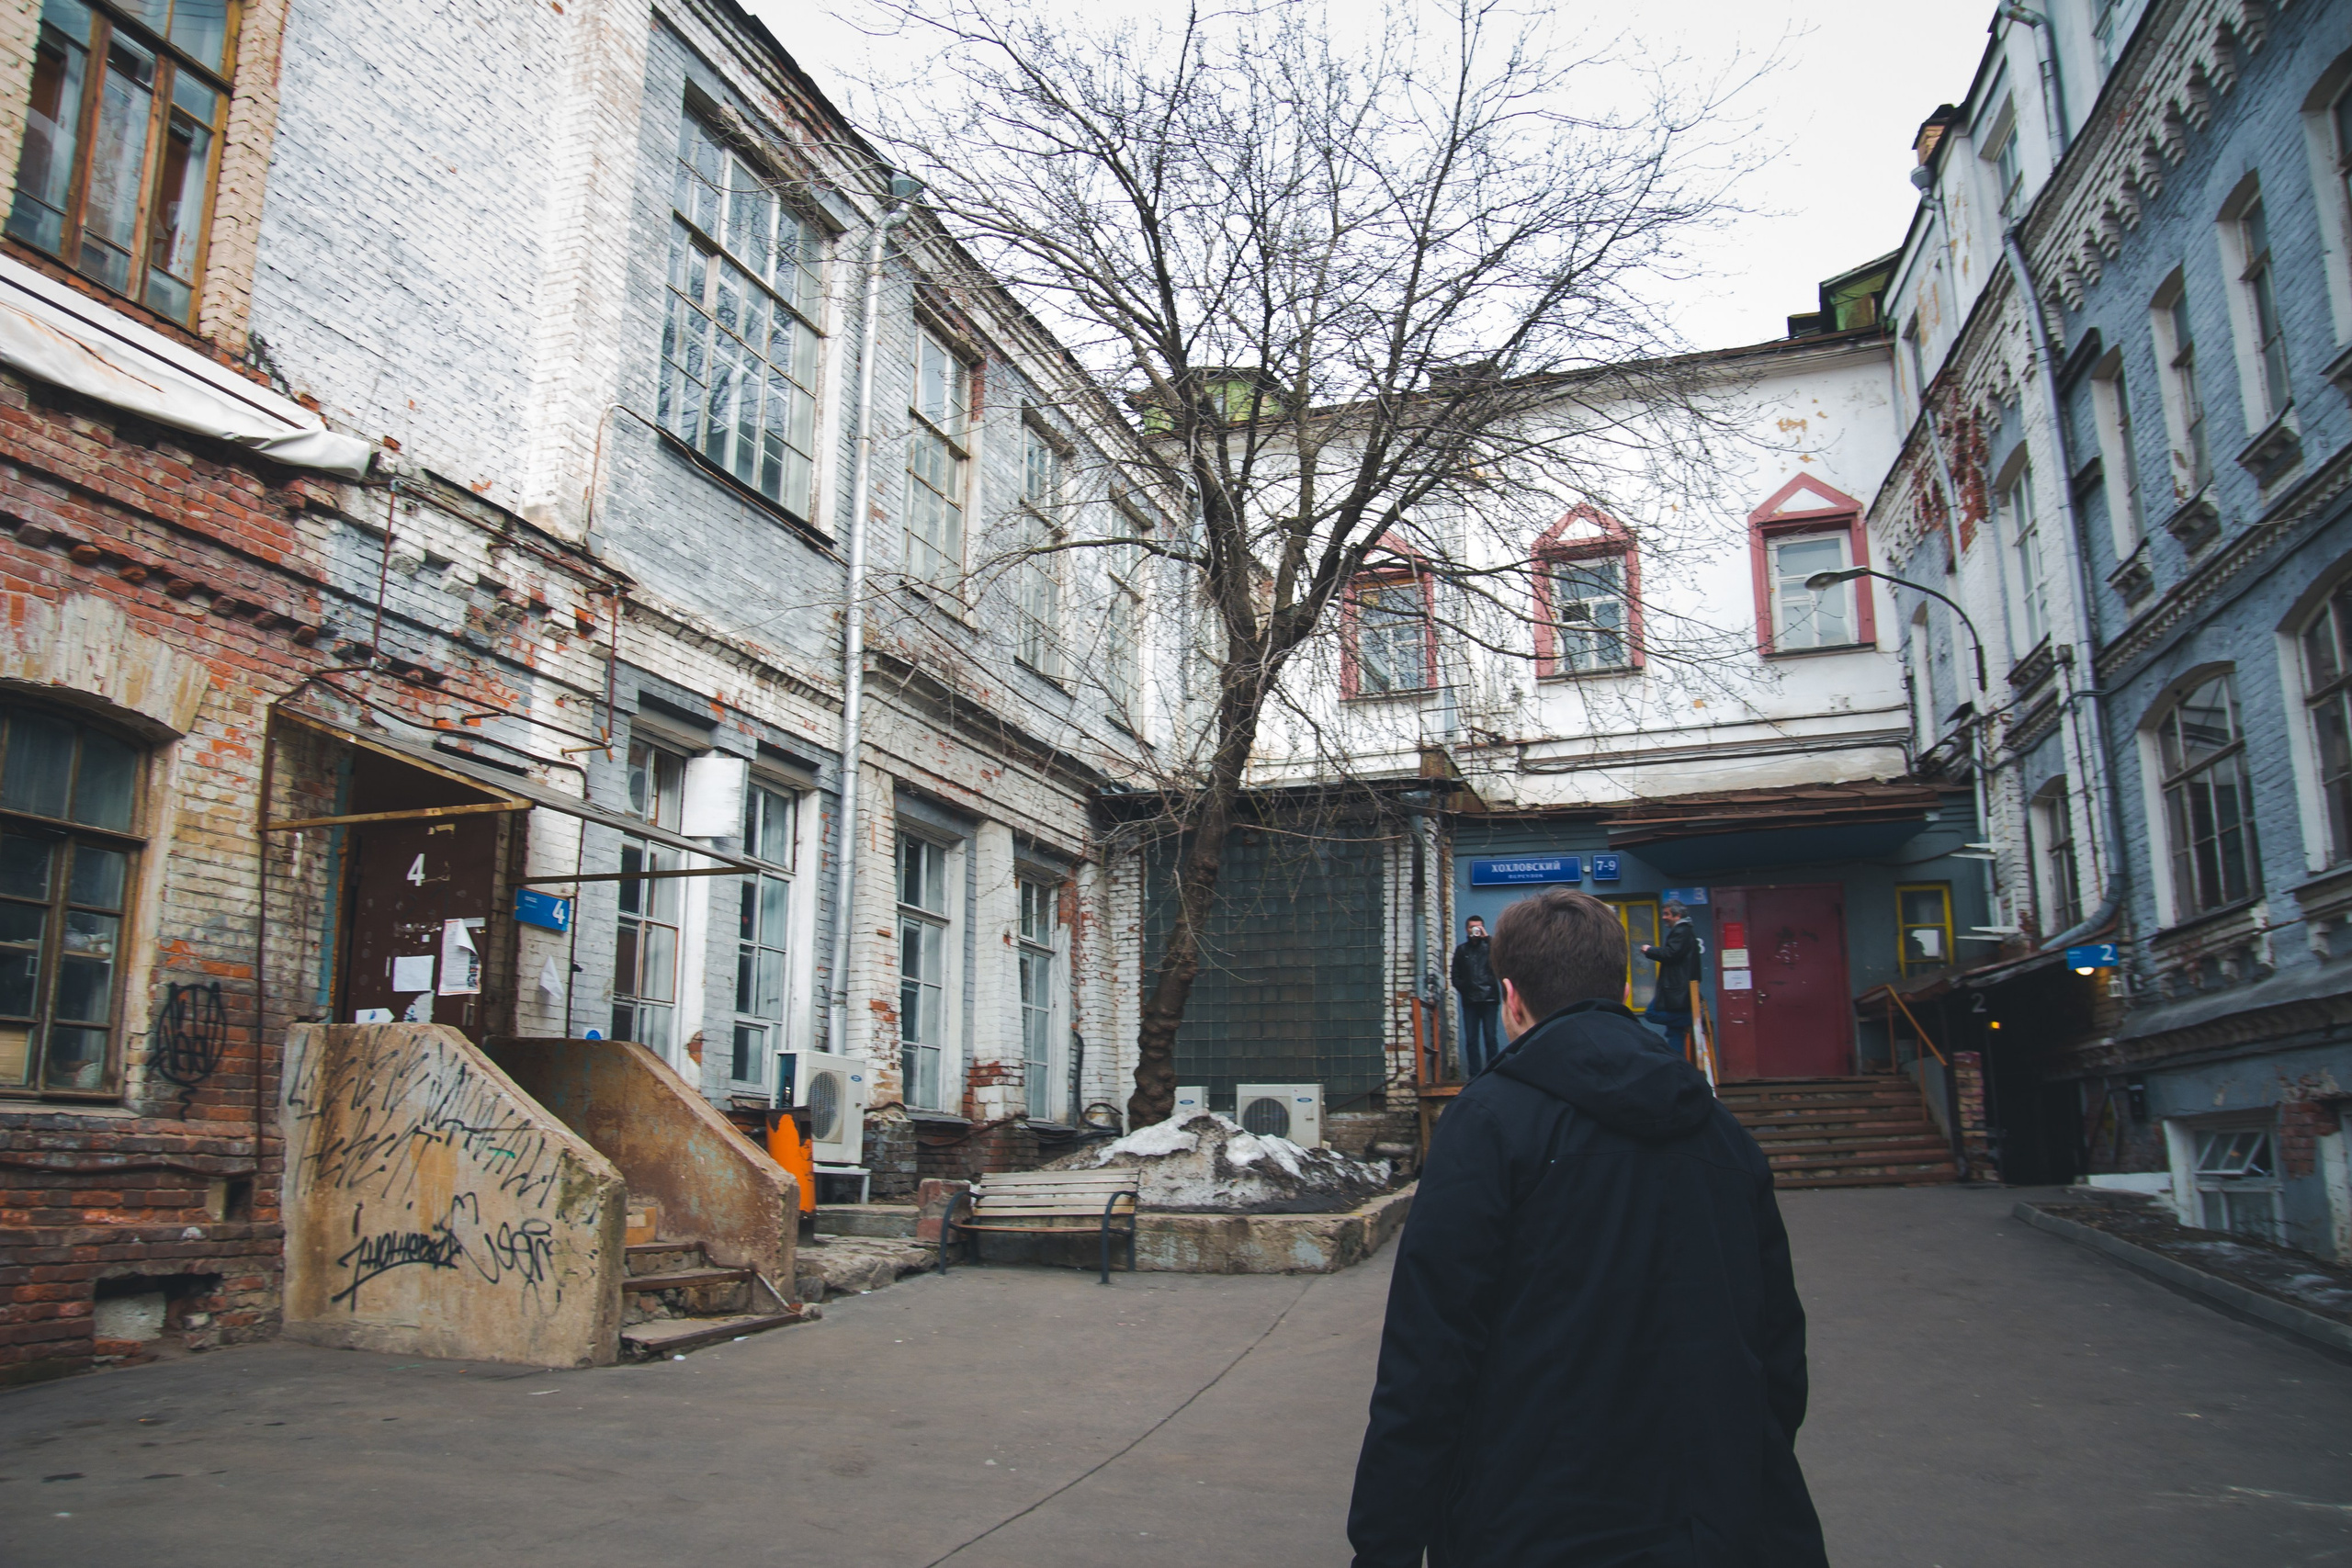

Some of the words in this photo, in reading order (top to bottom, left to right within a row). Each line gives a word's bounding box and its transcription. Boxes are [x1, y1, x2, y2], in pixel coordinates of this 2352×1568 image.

[406, 852, 425, 886] 4
[1491, 860, 1561, 873] ХОХЛОВСКИЙ
[1596, 860, 1617, 872] 7-9
[1693, 887, 1705, 900] 3
[552, 900, 566, 925] 4
[2099, 944, 2115, 961] 2
[1971, 992, 1987, 1013] 2
